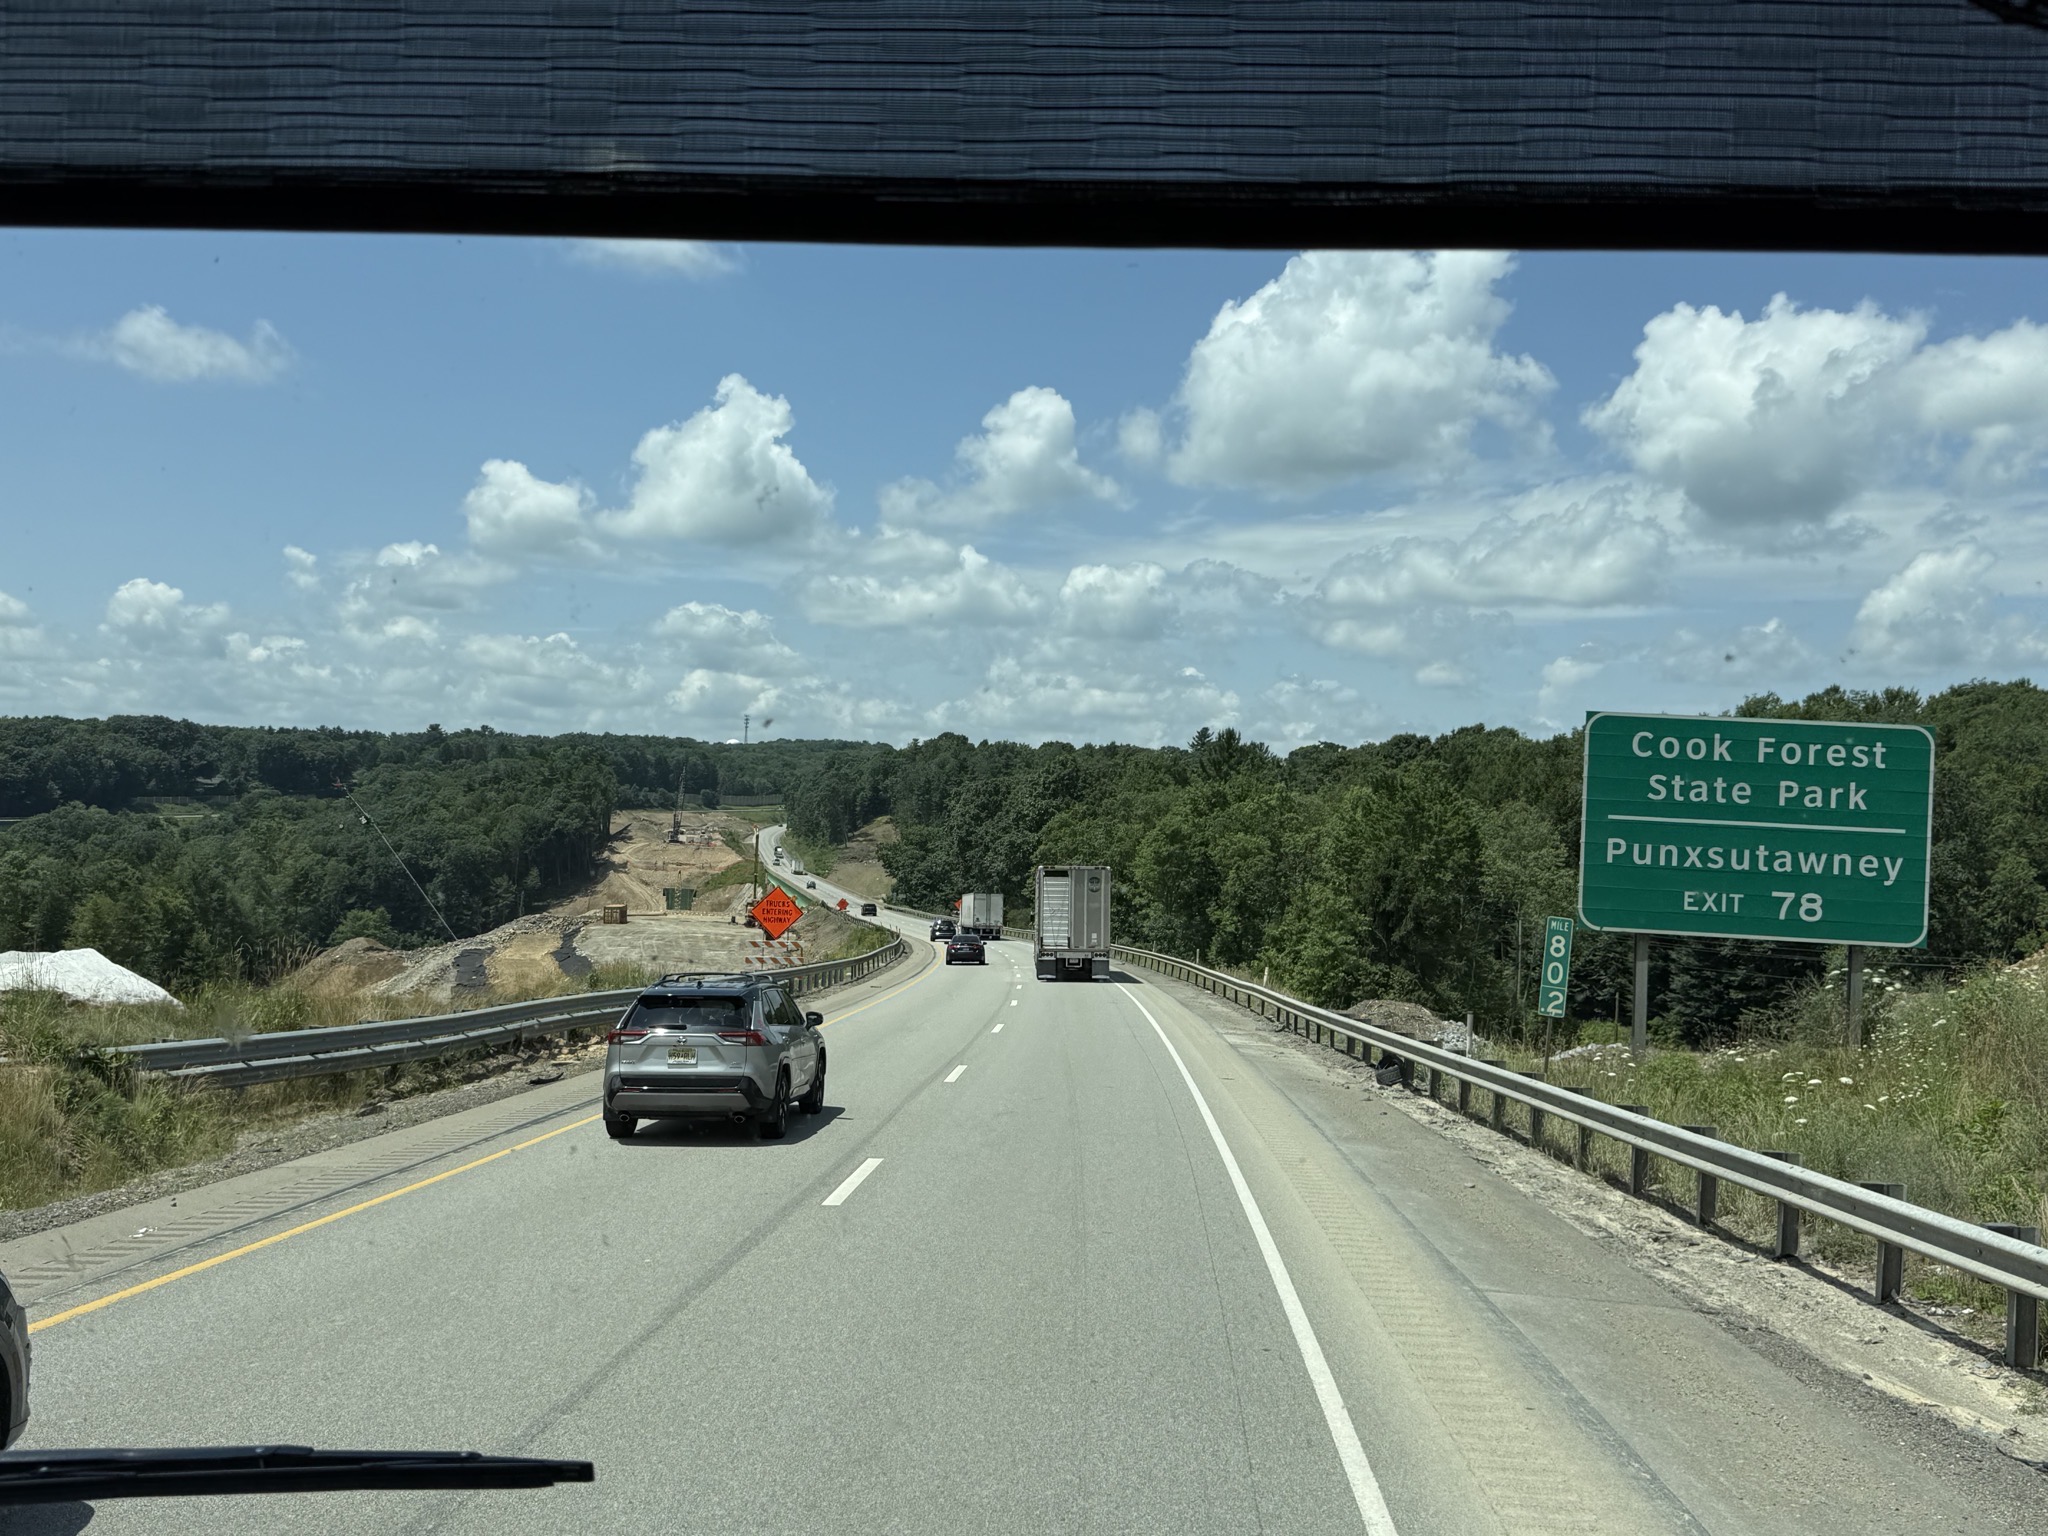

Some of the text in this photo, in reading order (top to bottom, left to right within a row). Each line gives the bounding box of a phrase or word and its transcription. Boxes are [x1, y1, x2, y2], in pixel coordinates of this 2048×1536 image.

[1631, 731, 1887, 769] Cook Forest
[1647, 774, 1868, 811] State Park
[1606, 837, 1904, 886] Punxsutawney
[762, 908, 793, 916] ENTERING
[766, 900, 790, 908] TRUCKS
[1683, 891, 1823, 923] EXIT 78
[763, 916, 791, 924] HIGHWAY
[1550, 920, 1569, 932] MILE
